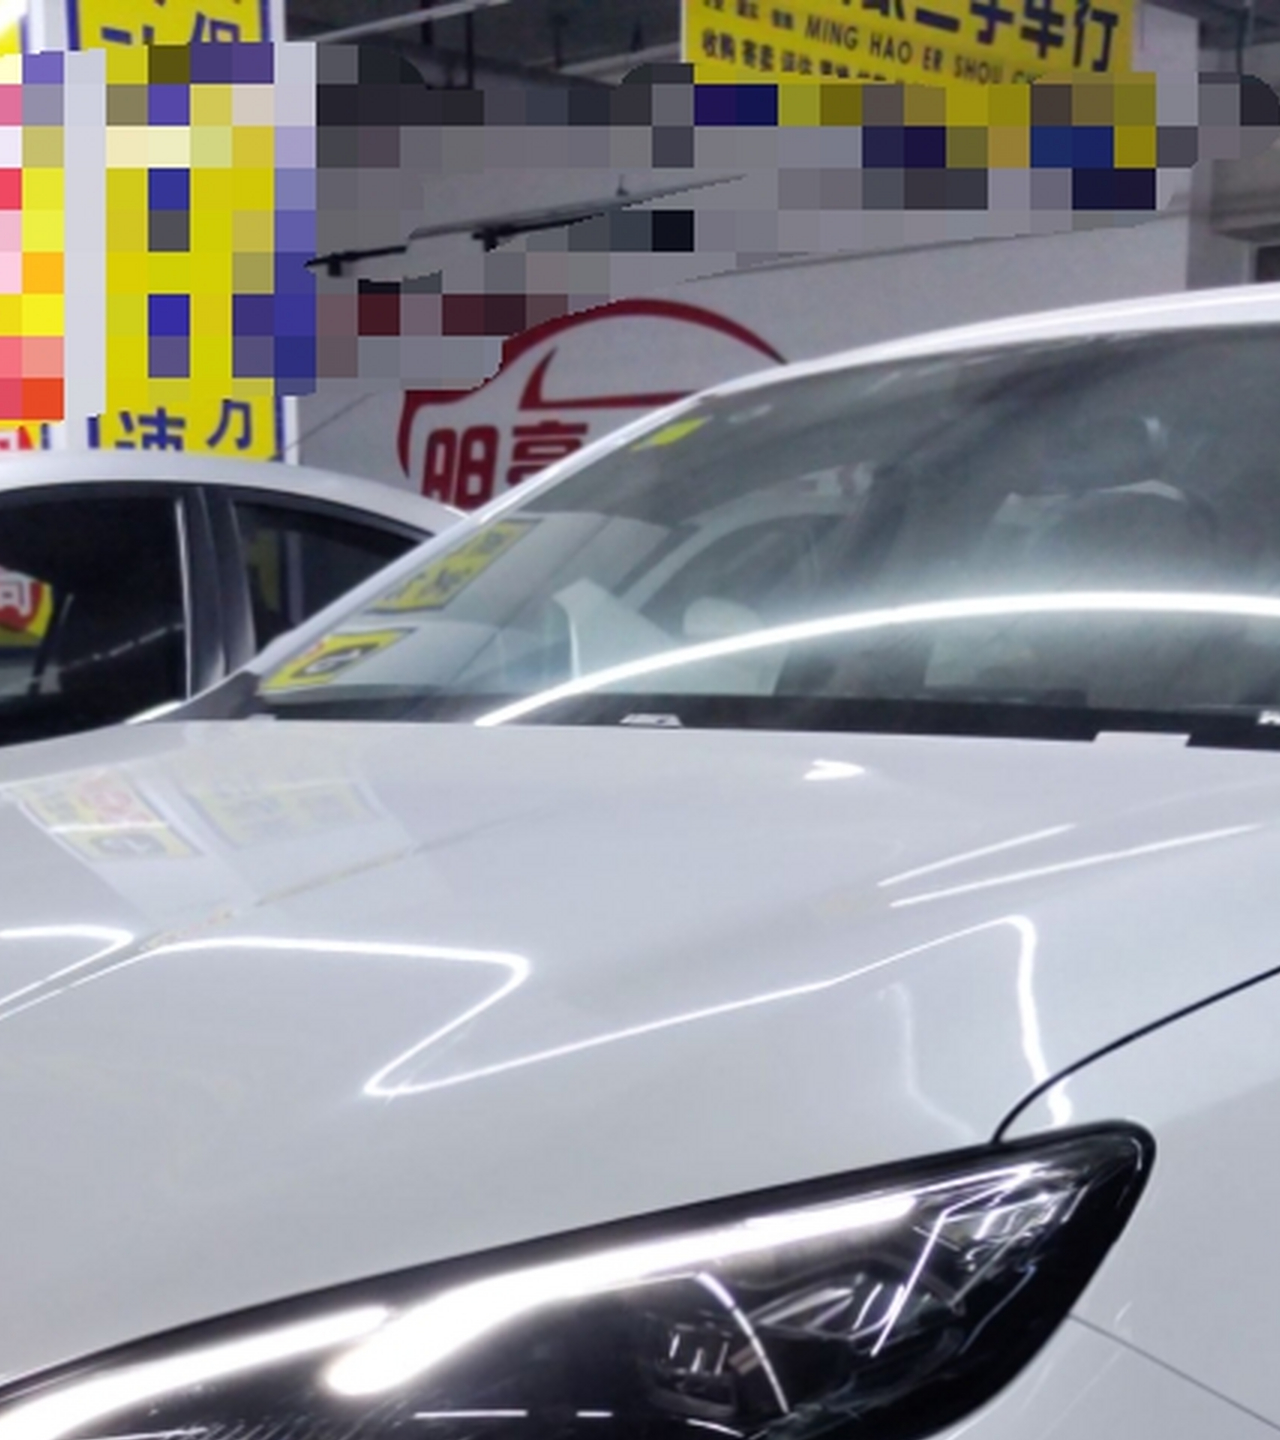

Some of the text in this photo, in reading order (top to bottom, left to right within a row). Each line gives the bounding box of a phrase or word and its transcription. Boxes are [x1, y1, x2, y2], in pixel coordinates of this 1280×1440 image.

[804, 14, 859, 51] MING
[869, 31, 913, 65] HAO
[922, 46, 943, 73] ER
